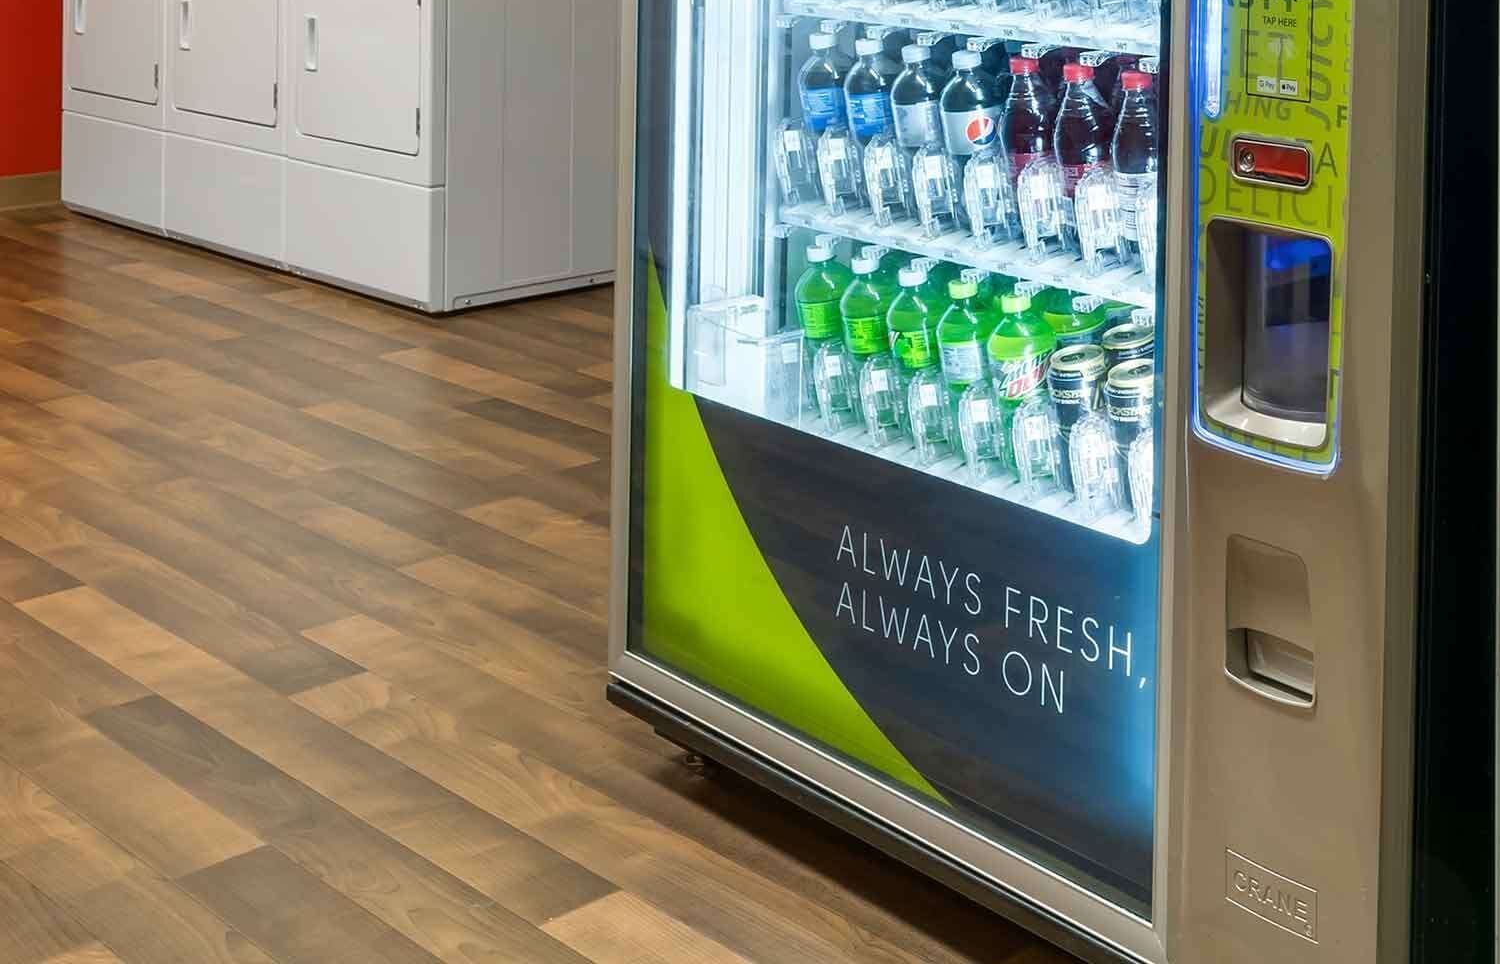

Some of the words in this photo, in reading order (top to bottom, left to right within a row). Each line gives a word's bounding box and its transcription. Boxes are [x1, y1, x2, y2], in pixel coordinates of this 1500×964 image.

[1263, 16, 1277, 26] TAP
[1278, 17, 1297, 28] HERE
[835, 582, 981, 676] ALWAYS
[1002, 651, 1064, 714] ON
[836, 525, 982, 616] ALWAYS
[1005, 586, 1147, 689] FRESH,
[1233, 871, 1308, 923] CRANE
